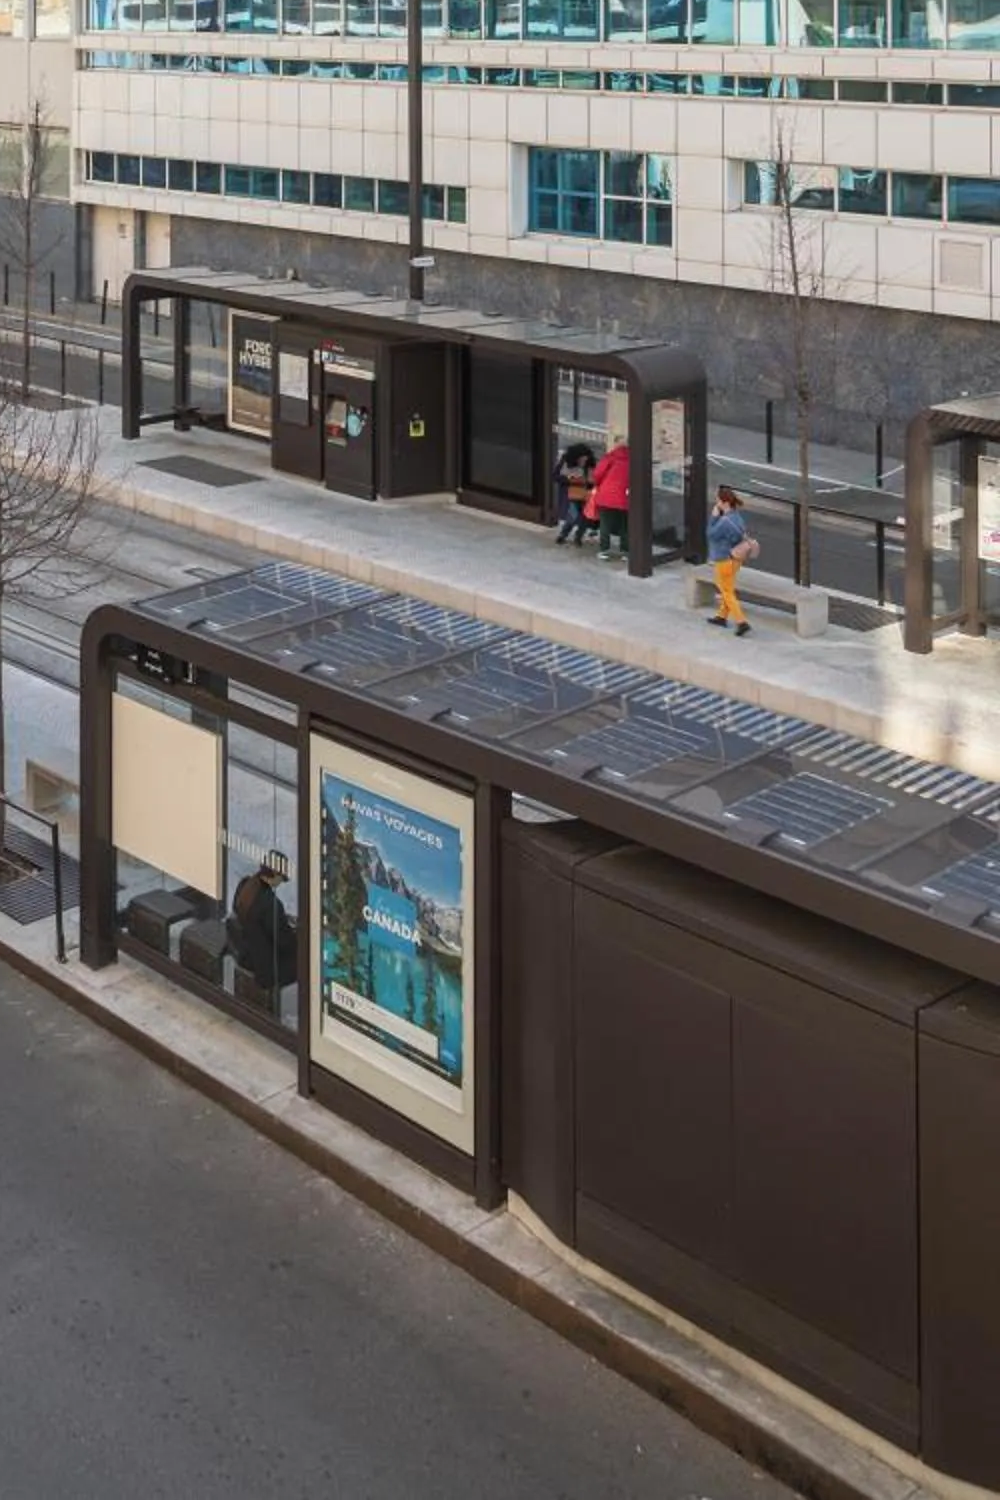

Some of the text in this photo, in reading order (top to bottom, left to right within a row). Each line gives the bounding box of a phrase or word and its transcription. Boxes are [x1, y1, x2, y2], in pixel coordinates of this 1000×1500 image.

[340, 796, 381, 822] HAVAS
[383, 814, 443, 850] VOYAGES
[362, 905, 422, 947] CANADA
